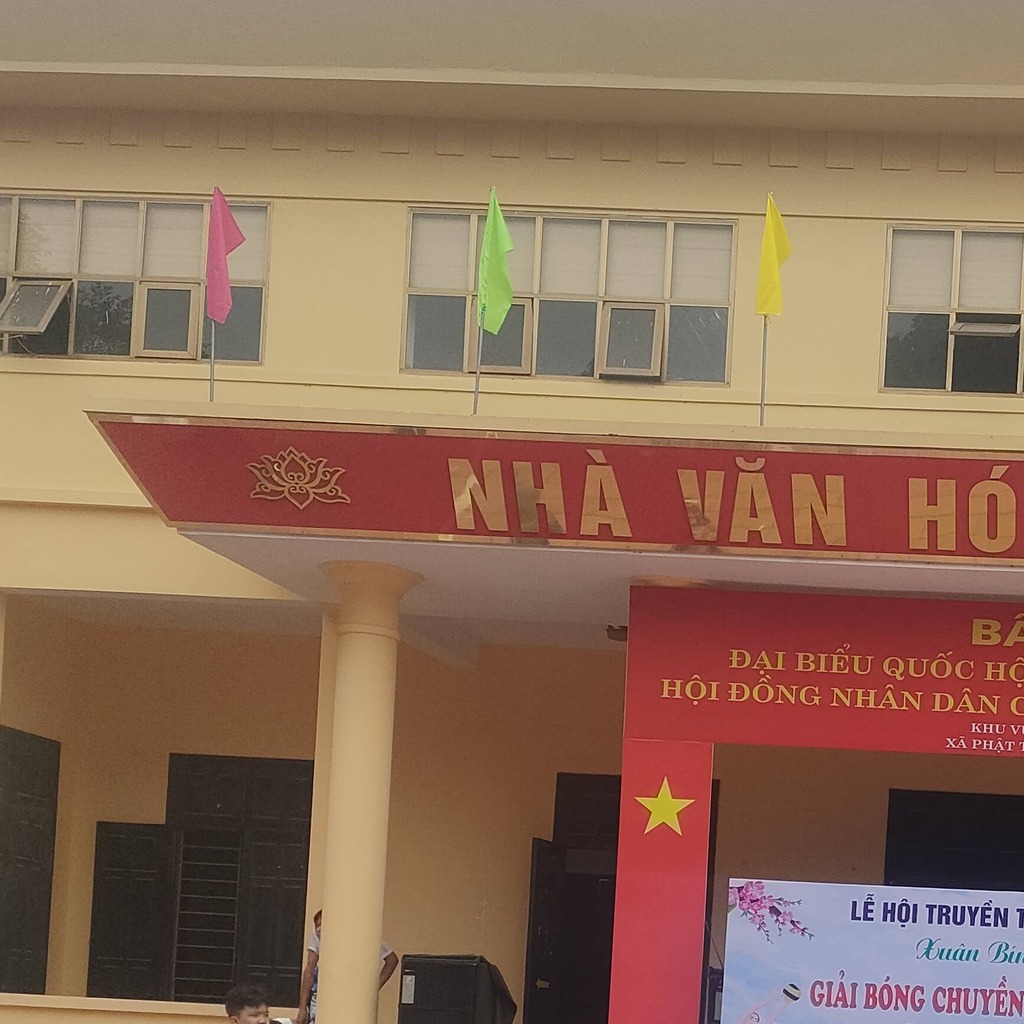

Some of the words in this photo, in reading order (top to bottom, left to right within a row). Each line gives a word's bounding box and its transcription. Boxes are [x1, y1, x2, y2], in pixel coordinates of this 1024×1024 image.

[447, 449, 633, 538] NHÀ
[677, 456, 847, 547] VĂN
[728, 648, 786, 675] ĐẠI
[795, 643, 875, 676] BIỂU
[882, 651, 975, 681] QUỐC
[660, 675, 719, 706] HỘI
[727, 674, 822, 706] ĐỒNG
[829, 684, 924, 711] NHÂN
[930, 687, 999, 715] DÂN
[945, 737, 968, 749] XÃ
[971, 737, 1015, 753] PHẬT
[971, 722, 1006, 736] KHU
[851, 894, 875, 922] LỄ
[882, 898, 918, 928] HỘI
[926, 900, 1009, 928] TRUYỀN
[916, 937, 980, 962] Xuân
[809, 970, 859, 1009] GIẢI
[864, 976, 925, 1012] BÓNG
